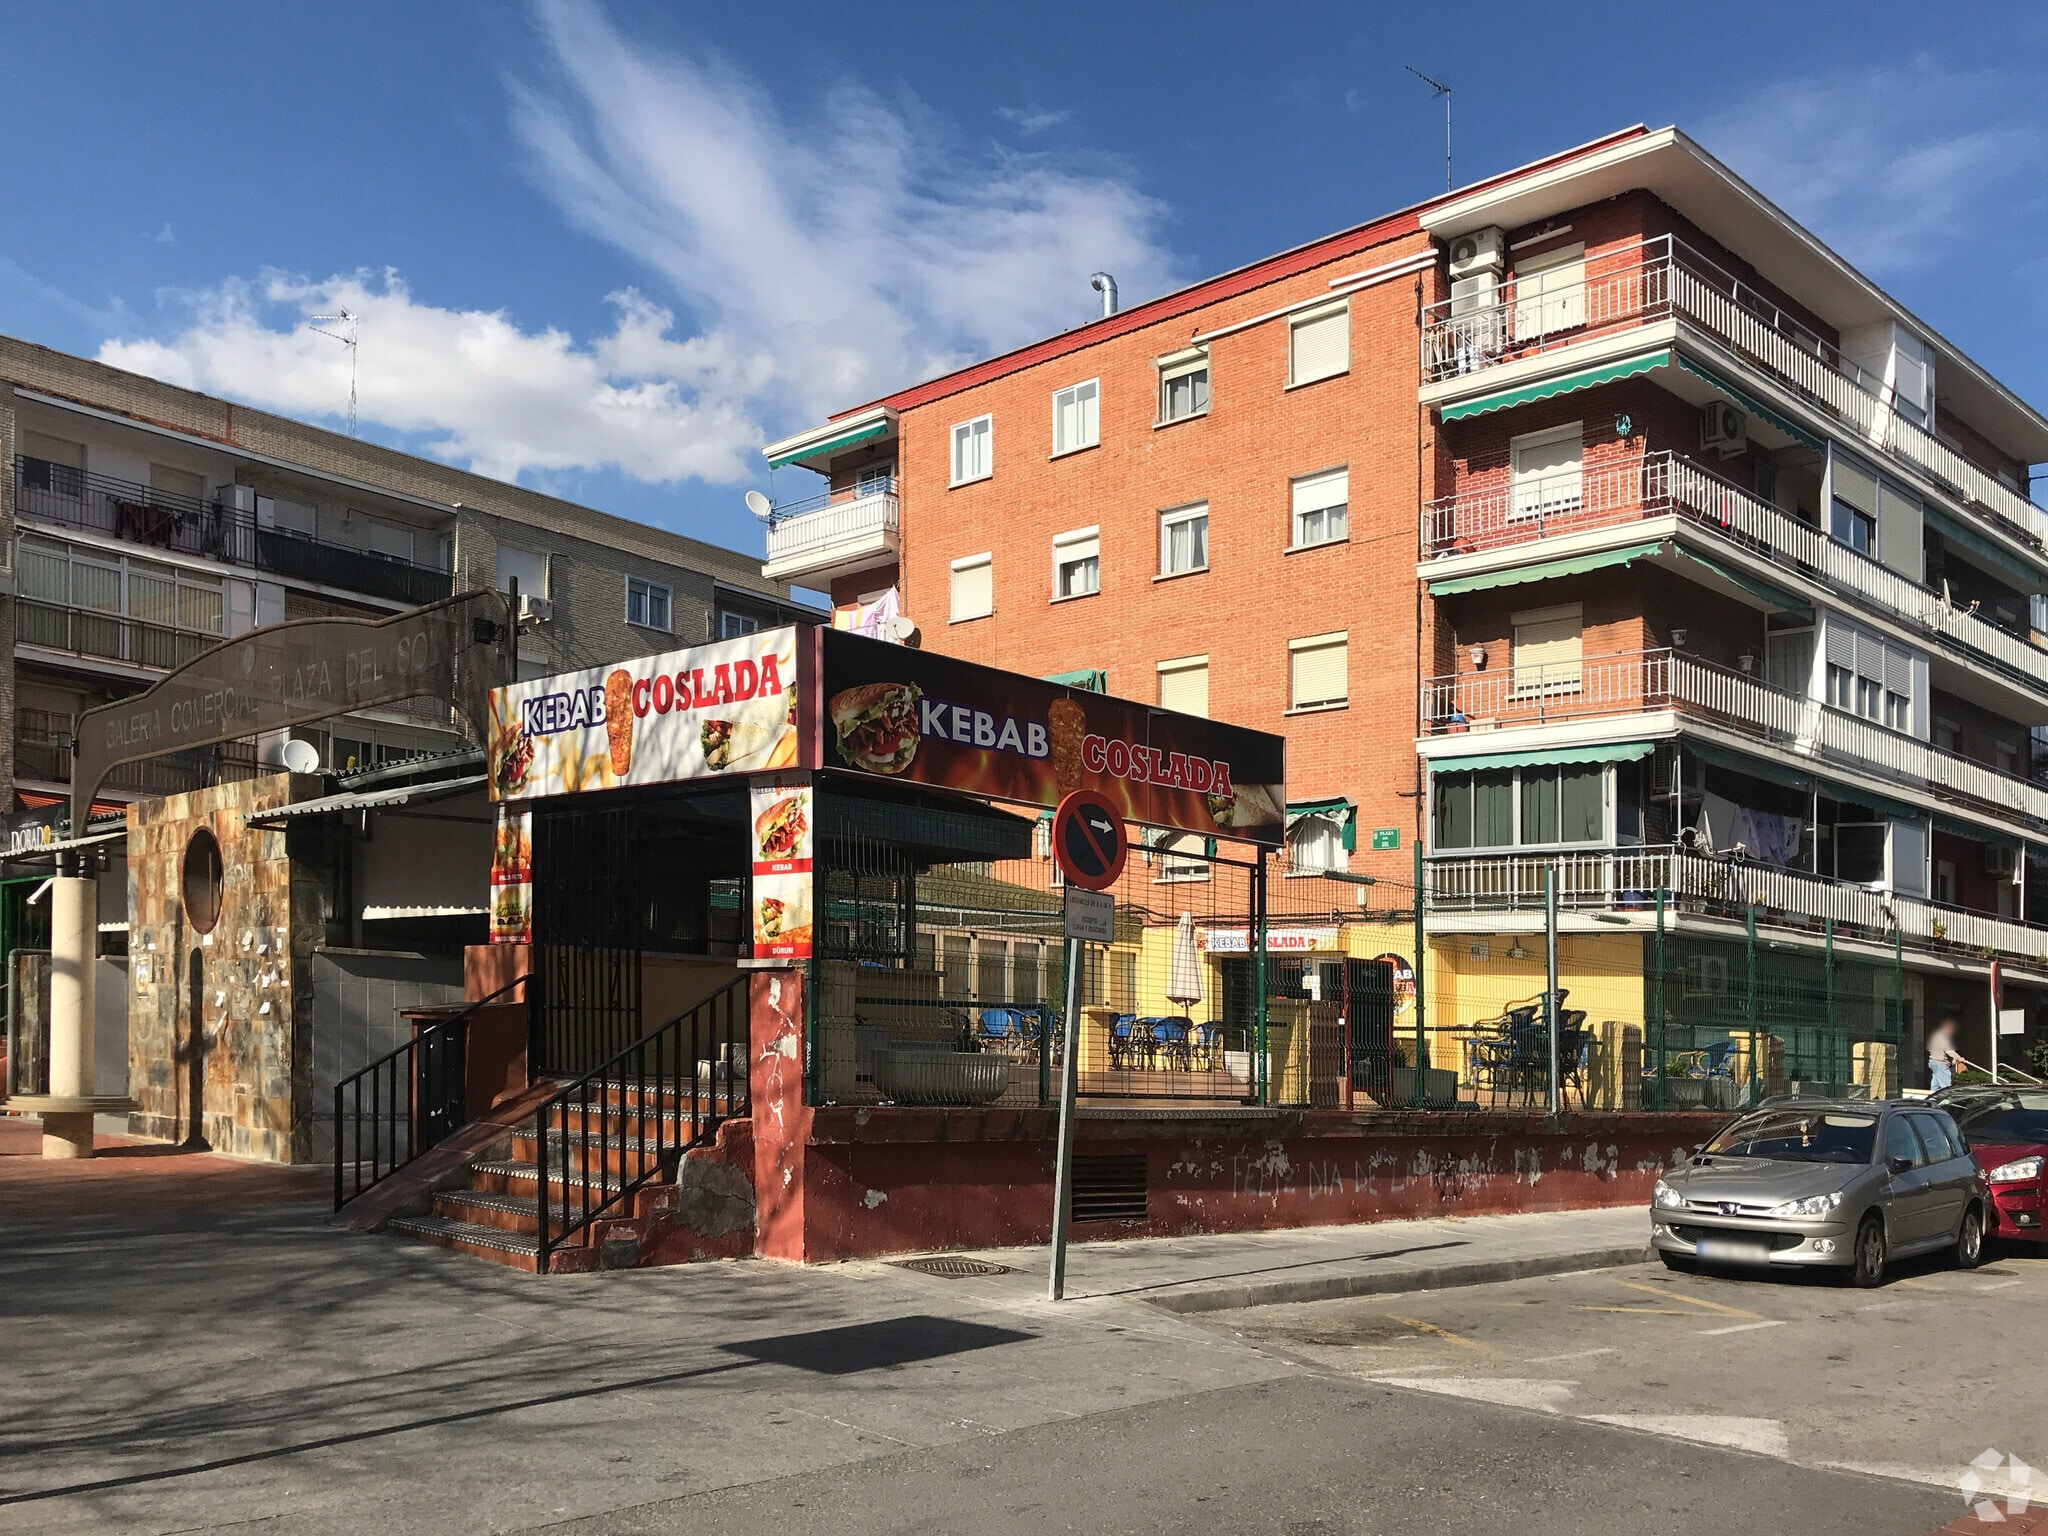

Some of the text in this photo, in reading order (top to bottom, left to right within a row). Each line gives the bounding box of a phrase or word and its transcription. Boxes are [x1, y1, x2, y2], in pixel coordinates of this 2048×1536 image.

[105, 630, 441, 749] GALERIA COMERCIAL PLAZA DEL SOL
[521, 653, 782, 737] KEBAB COSLADA
[919, 696, 1233, 798] KEBAB COSLADA
[771, 863, 793, 871] KEBAB
[1211, 937, 1246, 948] KEBAB
[1309, 1159, 1344, 1199] DIA
[1354, 1160, 1378, 1196] DE
